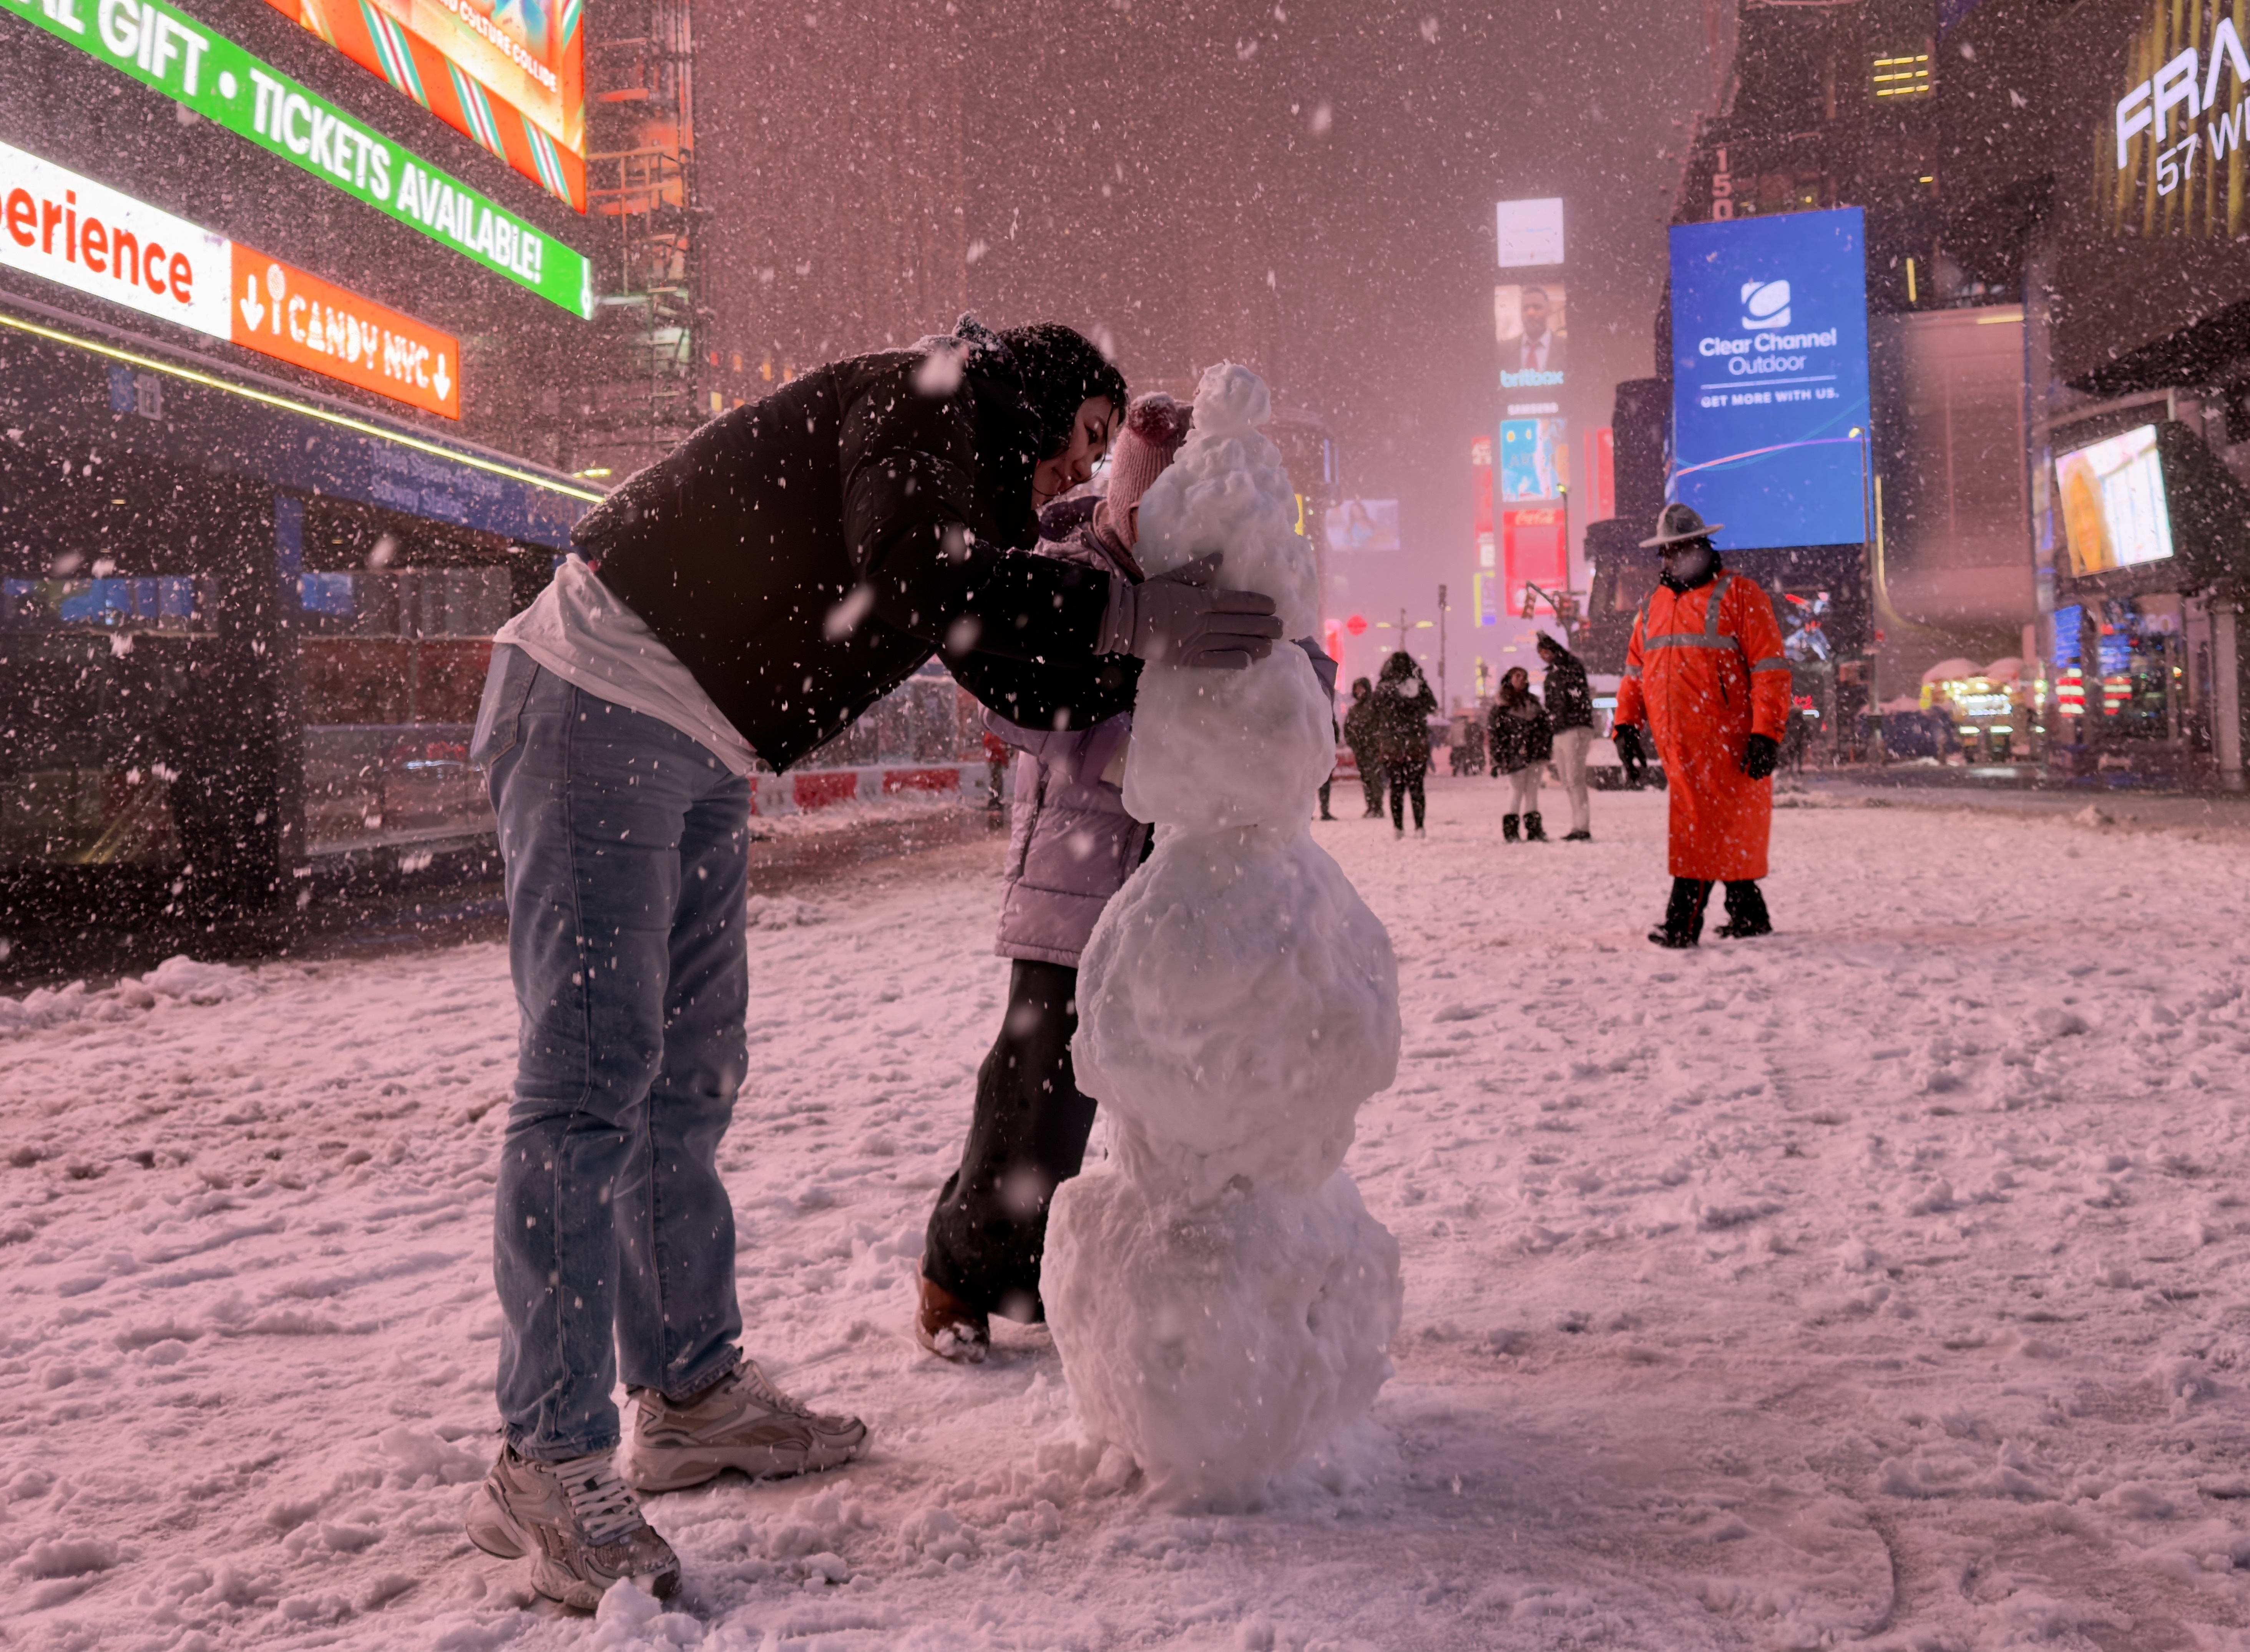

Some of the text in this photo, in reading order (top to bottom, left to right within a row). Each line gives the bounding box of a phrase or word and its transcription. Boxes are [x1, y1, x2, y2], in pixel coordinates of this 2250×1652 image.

[460, 1, 557, 93] CULTURE COLLIDE
[98, 0, 209, 96] GIFT
[249, 68, 391, 201] TICKETS
[396, 161, 543, 284] AVAILABLE!
[2157, 96, 2250, 196] 57 W
[1712, 149, 1733, 221] 150
[0, 188, 193, 304] erience
[384, 330, 429, 388] NYC
[1699, 327, 1837, 357] Clear Channel
[1729, 355, 1807, 375] Outdoor
[1700, 387, 1840, 408] GET MORE WITH US.
